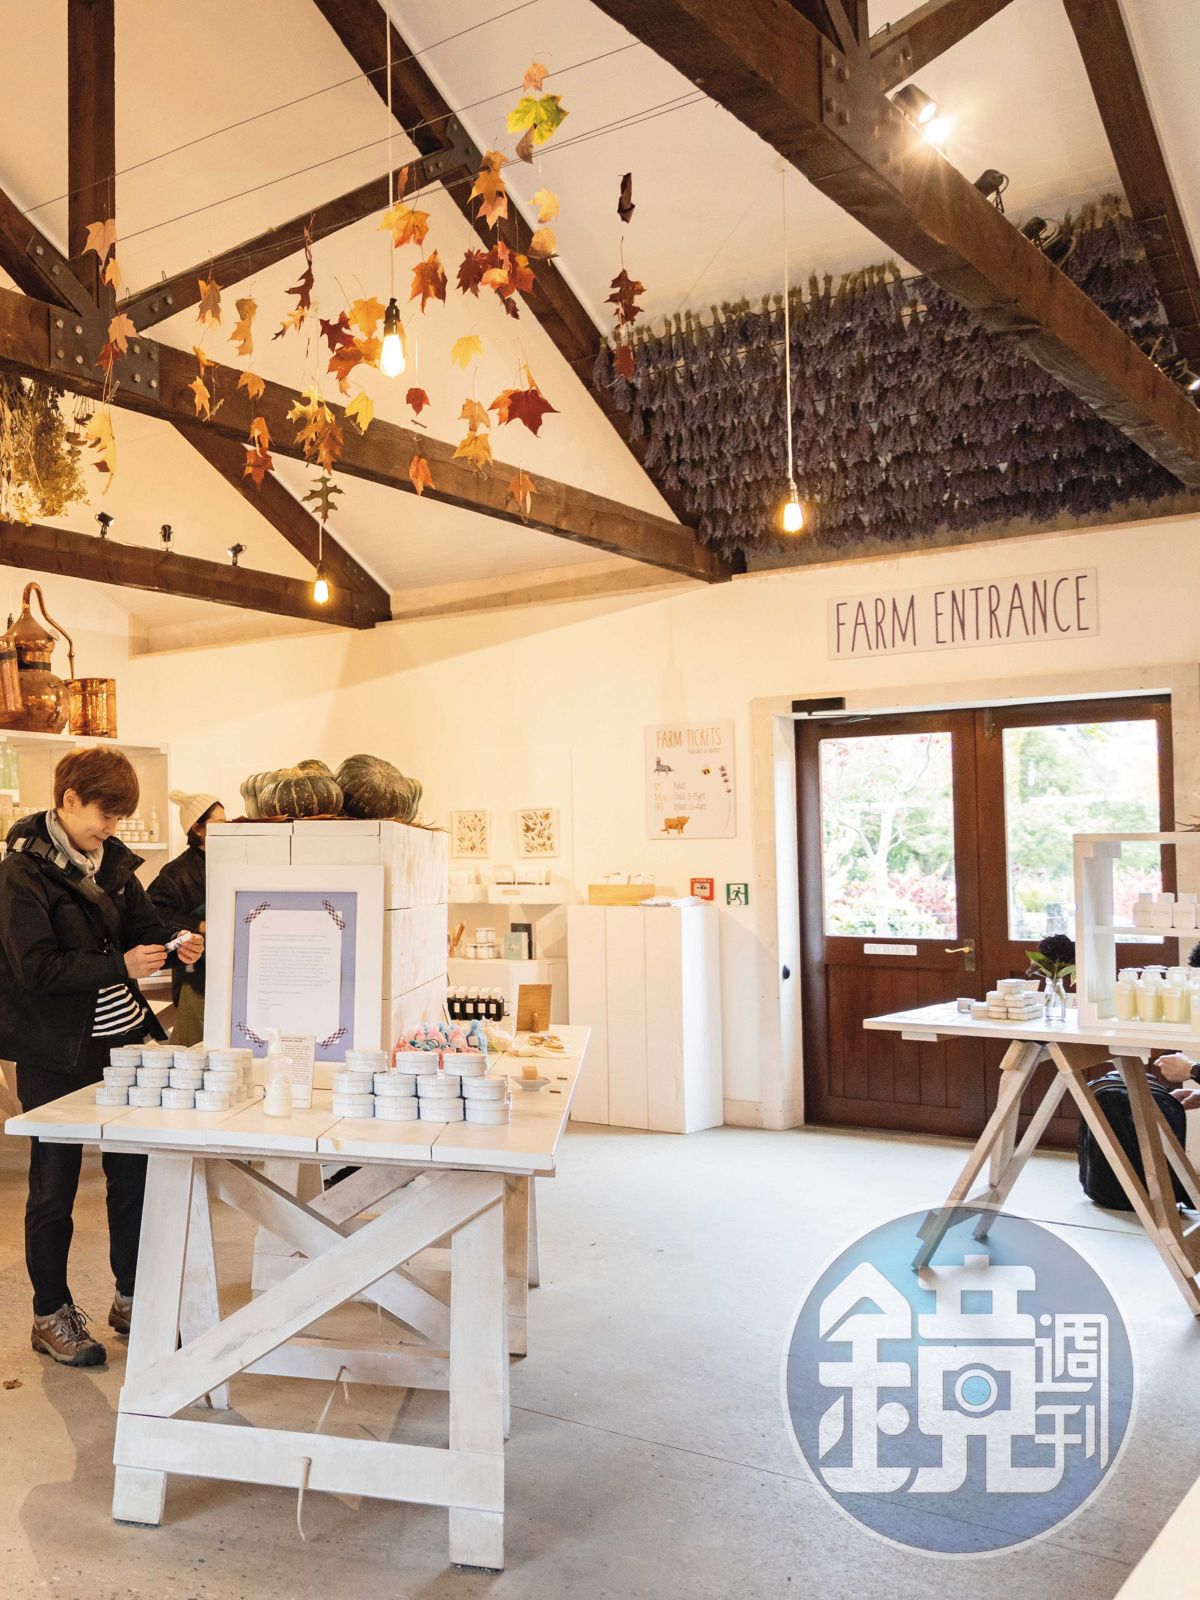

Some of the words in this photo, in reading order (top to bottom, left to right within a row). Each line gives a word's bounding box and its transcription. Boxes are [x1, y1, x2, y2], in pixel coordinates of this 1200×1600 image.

[836, 594, 917, 653] FARM
[934, 575, 1090, 644] ENTRANCE
[656, 730, 683, 749] FARM
[687, 727, 722, 748] TICKETS
